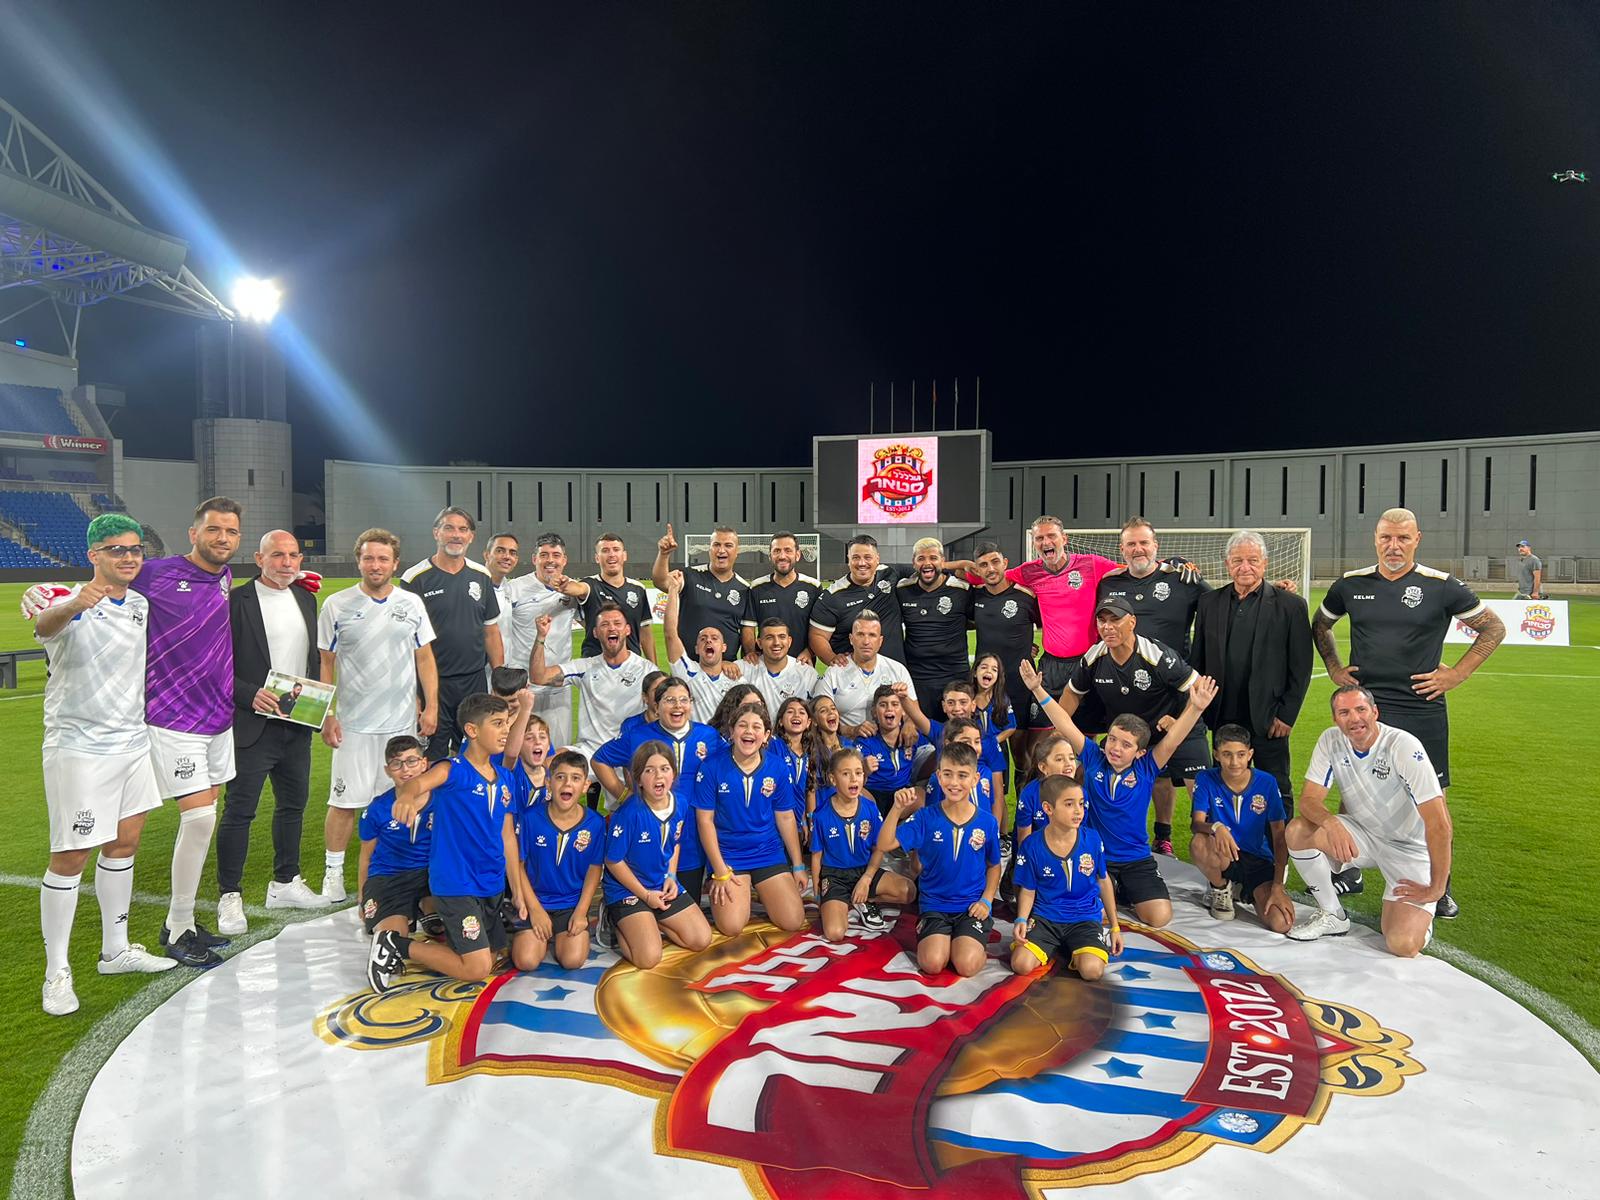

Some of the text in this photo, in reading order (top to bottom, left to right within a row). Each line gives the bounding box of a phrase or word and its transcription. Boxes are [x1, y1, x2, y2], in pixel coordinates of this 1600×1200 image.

[60, 438, 102, 449] Winner
[871, 478, 924, 493] סטאר
[423, 588, 444, 598] KELME
